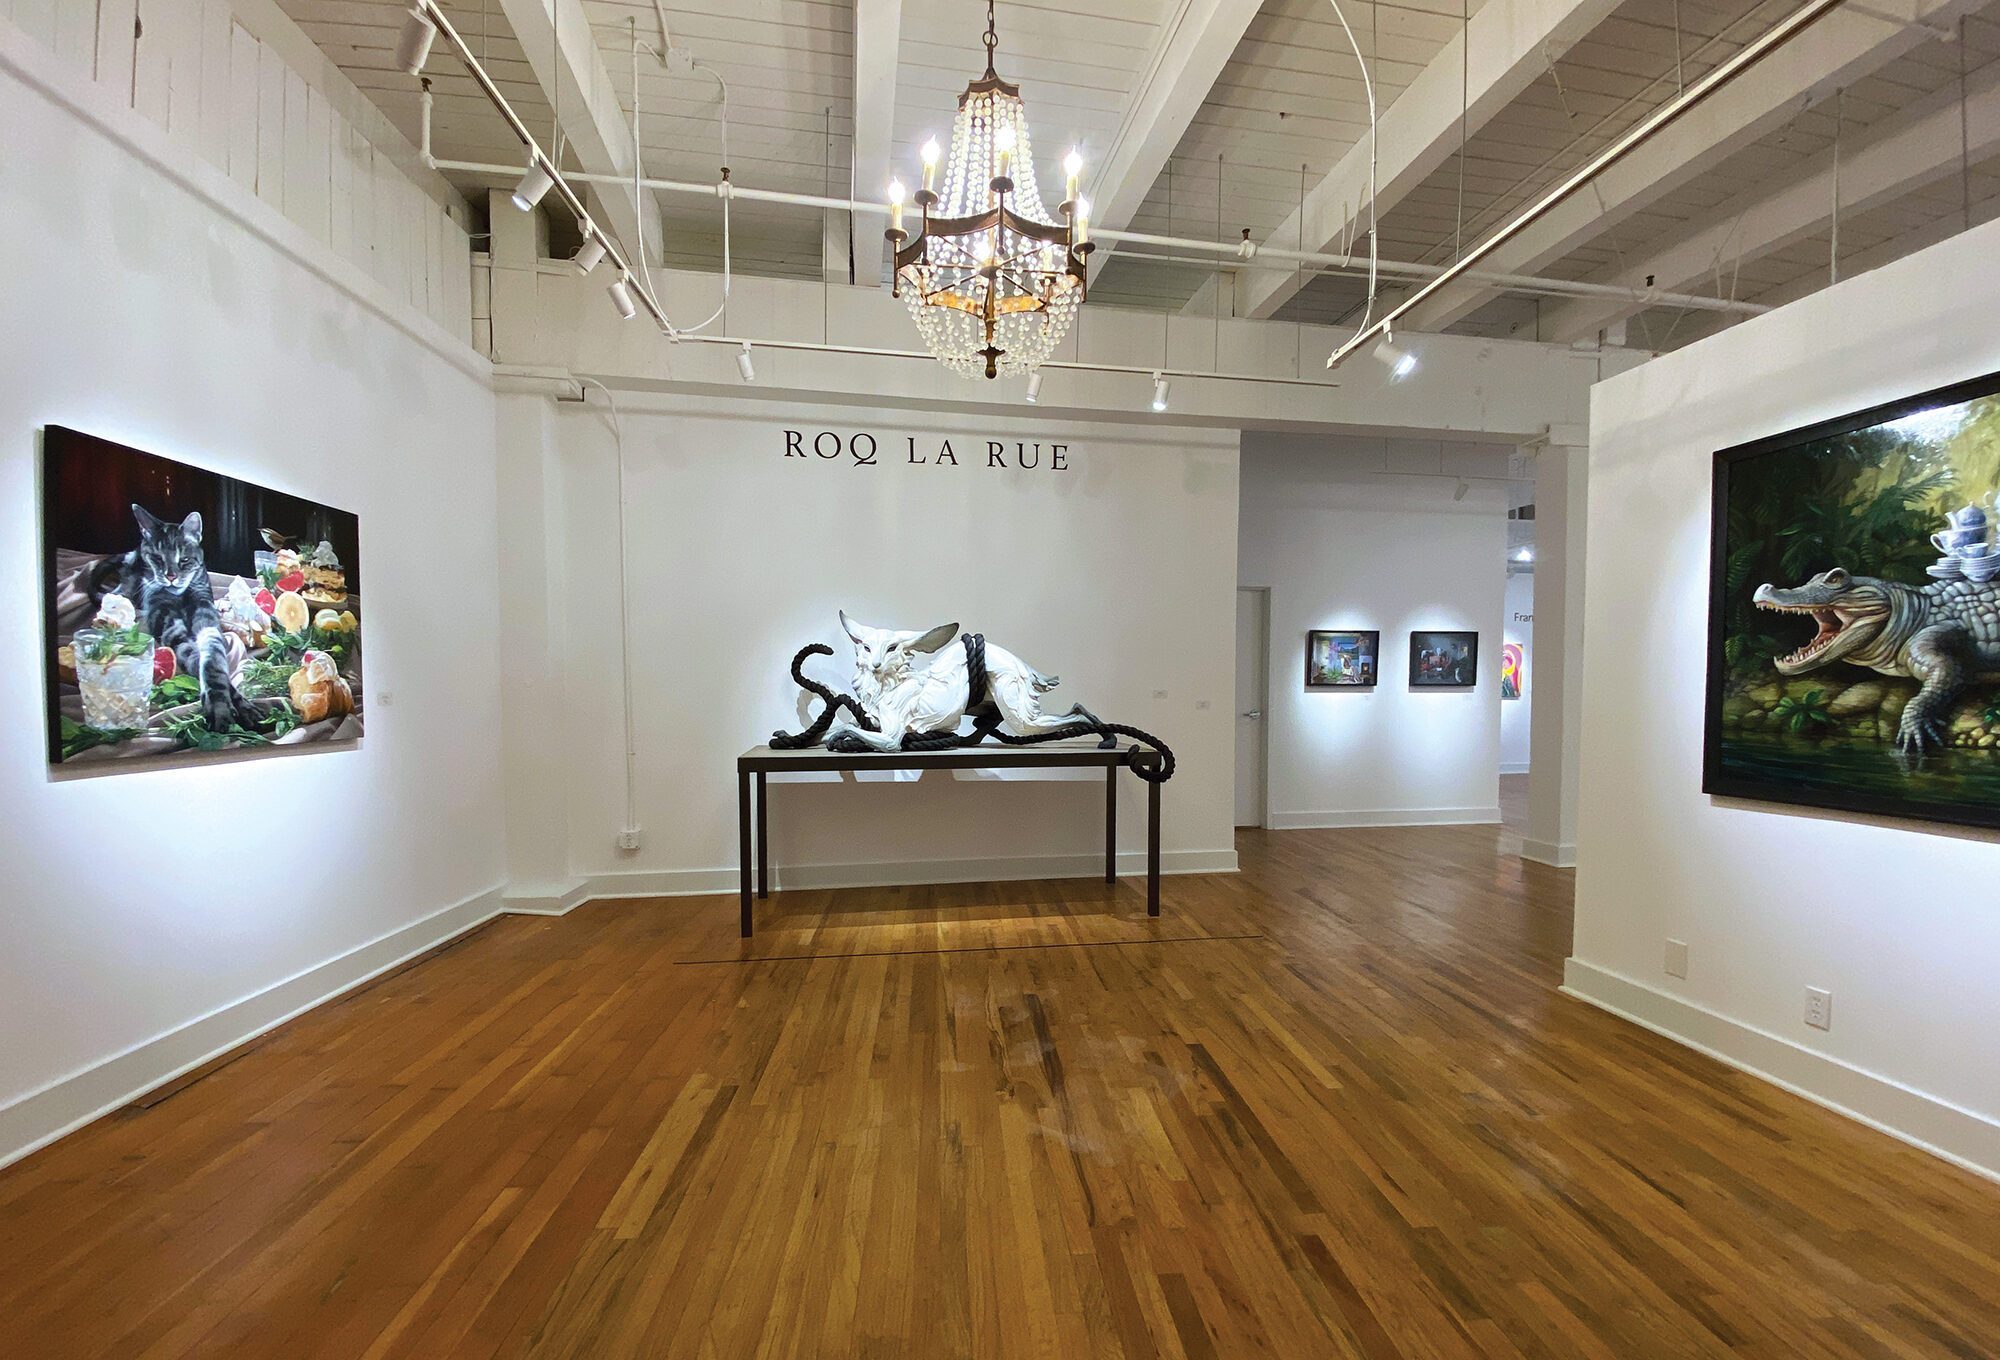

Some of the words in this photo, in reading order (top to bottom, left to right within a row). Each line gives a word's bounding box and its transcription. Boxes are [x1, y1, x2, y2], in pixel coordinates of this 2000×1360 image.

[783, 430, 877, 467] ROQ
[907, 437, 959, 466] LA
[986, 441, 1069, 471] RUE
